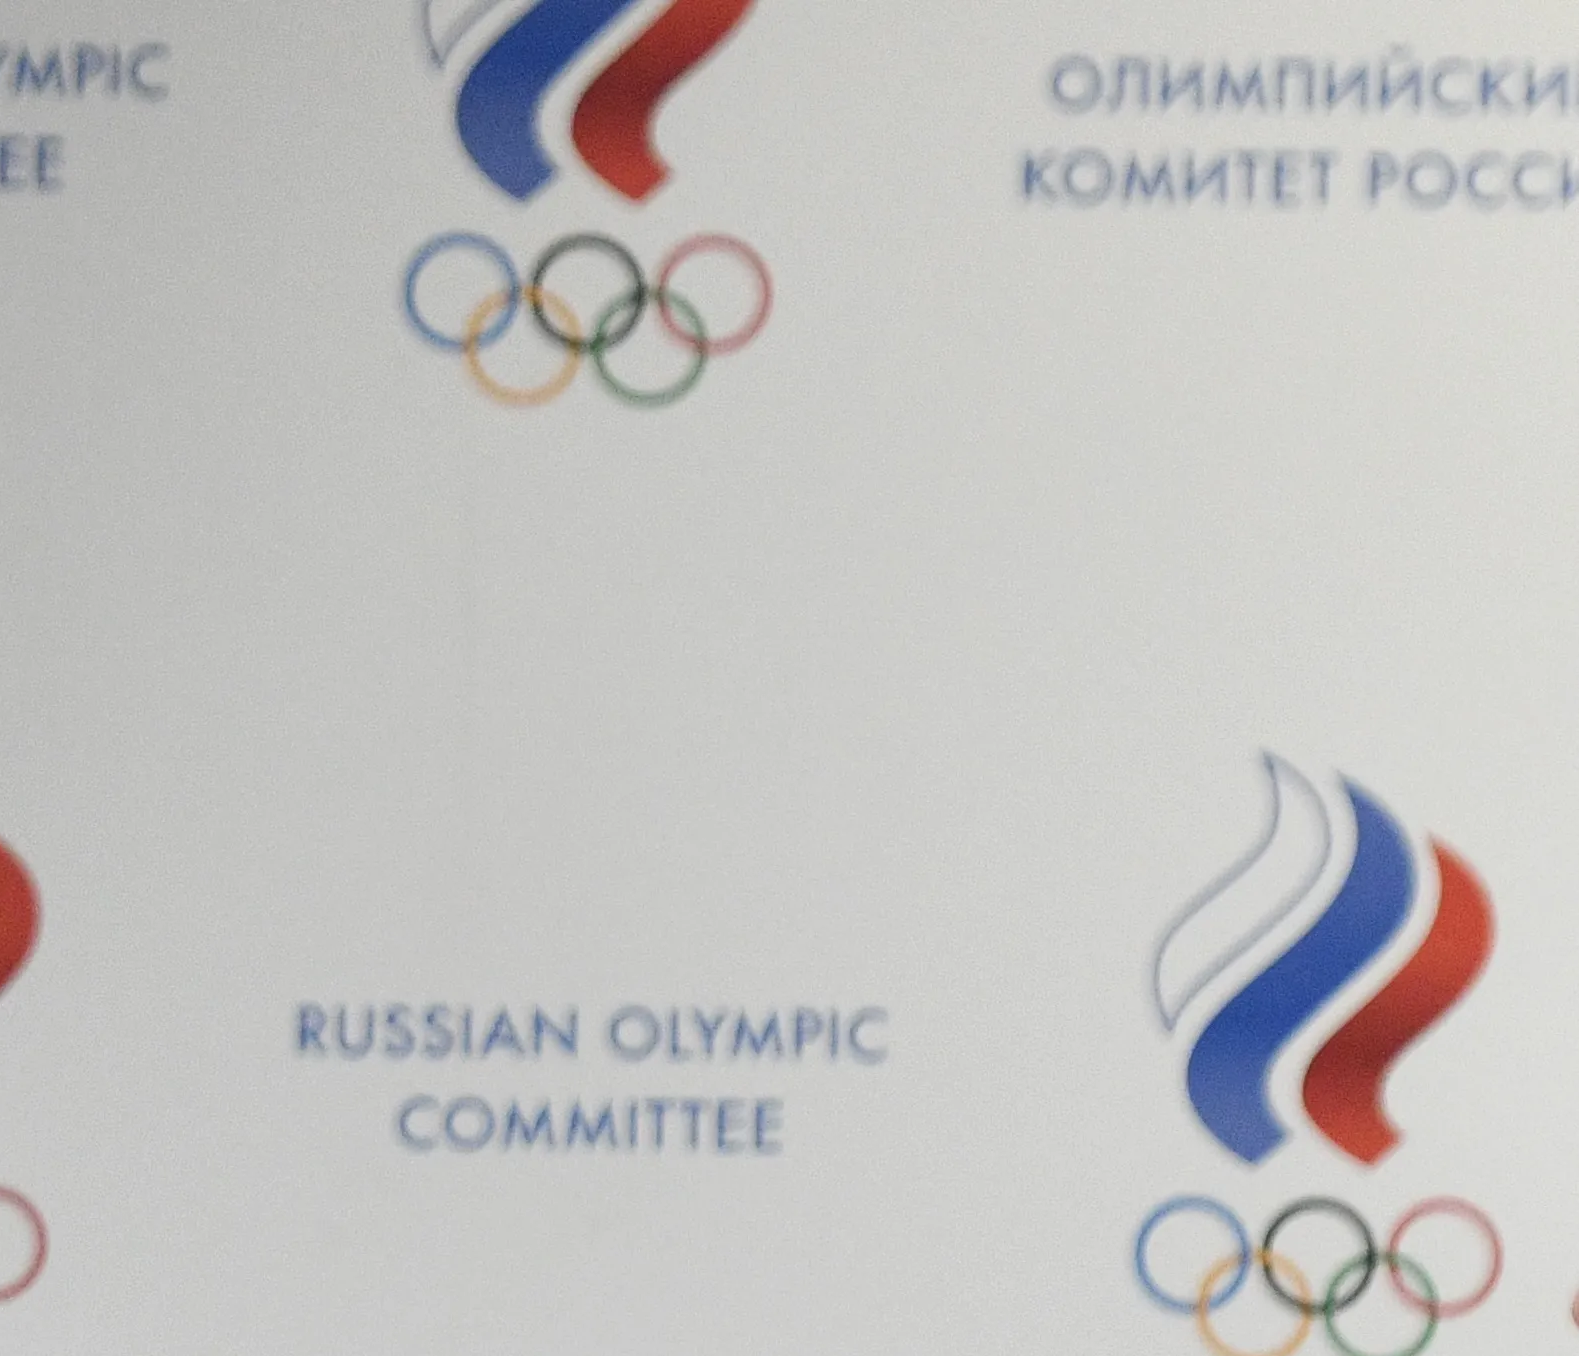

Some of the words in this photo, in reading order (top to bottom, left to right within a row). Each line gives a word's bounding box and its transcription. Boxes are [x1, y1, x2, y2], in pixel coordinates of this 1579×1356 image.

[1045, 42, 1579, 116] ОЛИМПИЙСКИ
[1017, 147, 1339, 208] КОМИТЕТ
[293, 1002, 579, 1061] RUSSIAN
[605, 1004, 890, 1066] OLYMPIC
[393, 1094, 784, 1154] COMMITTEE
